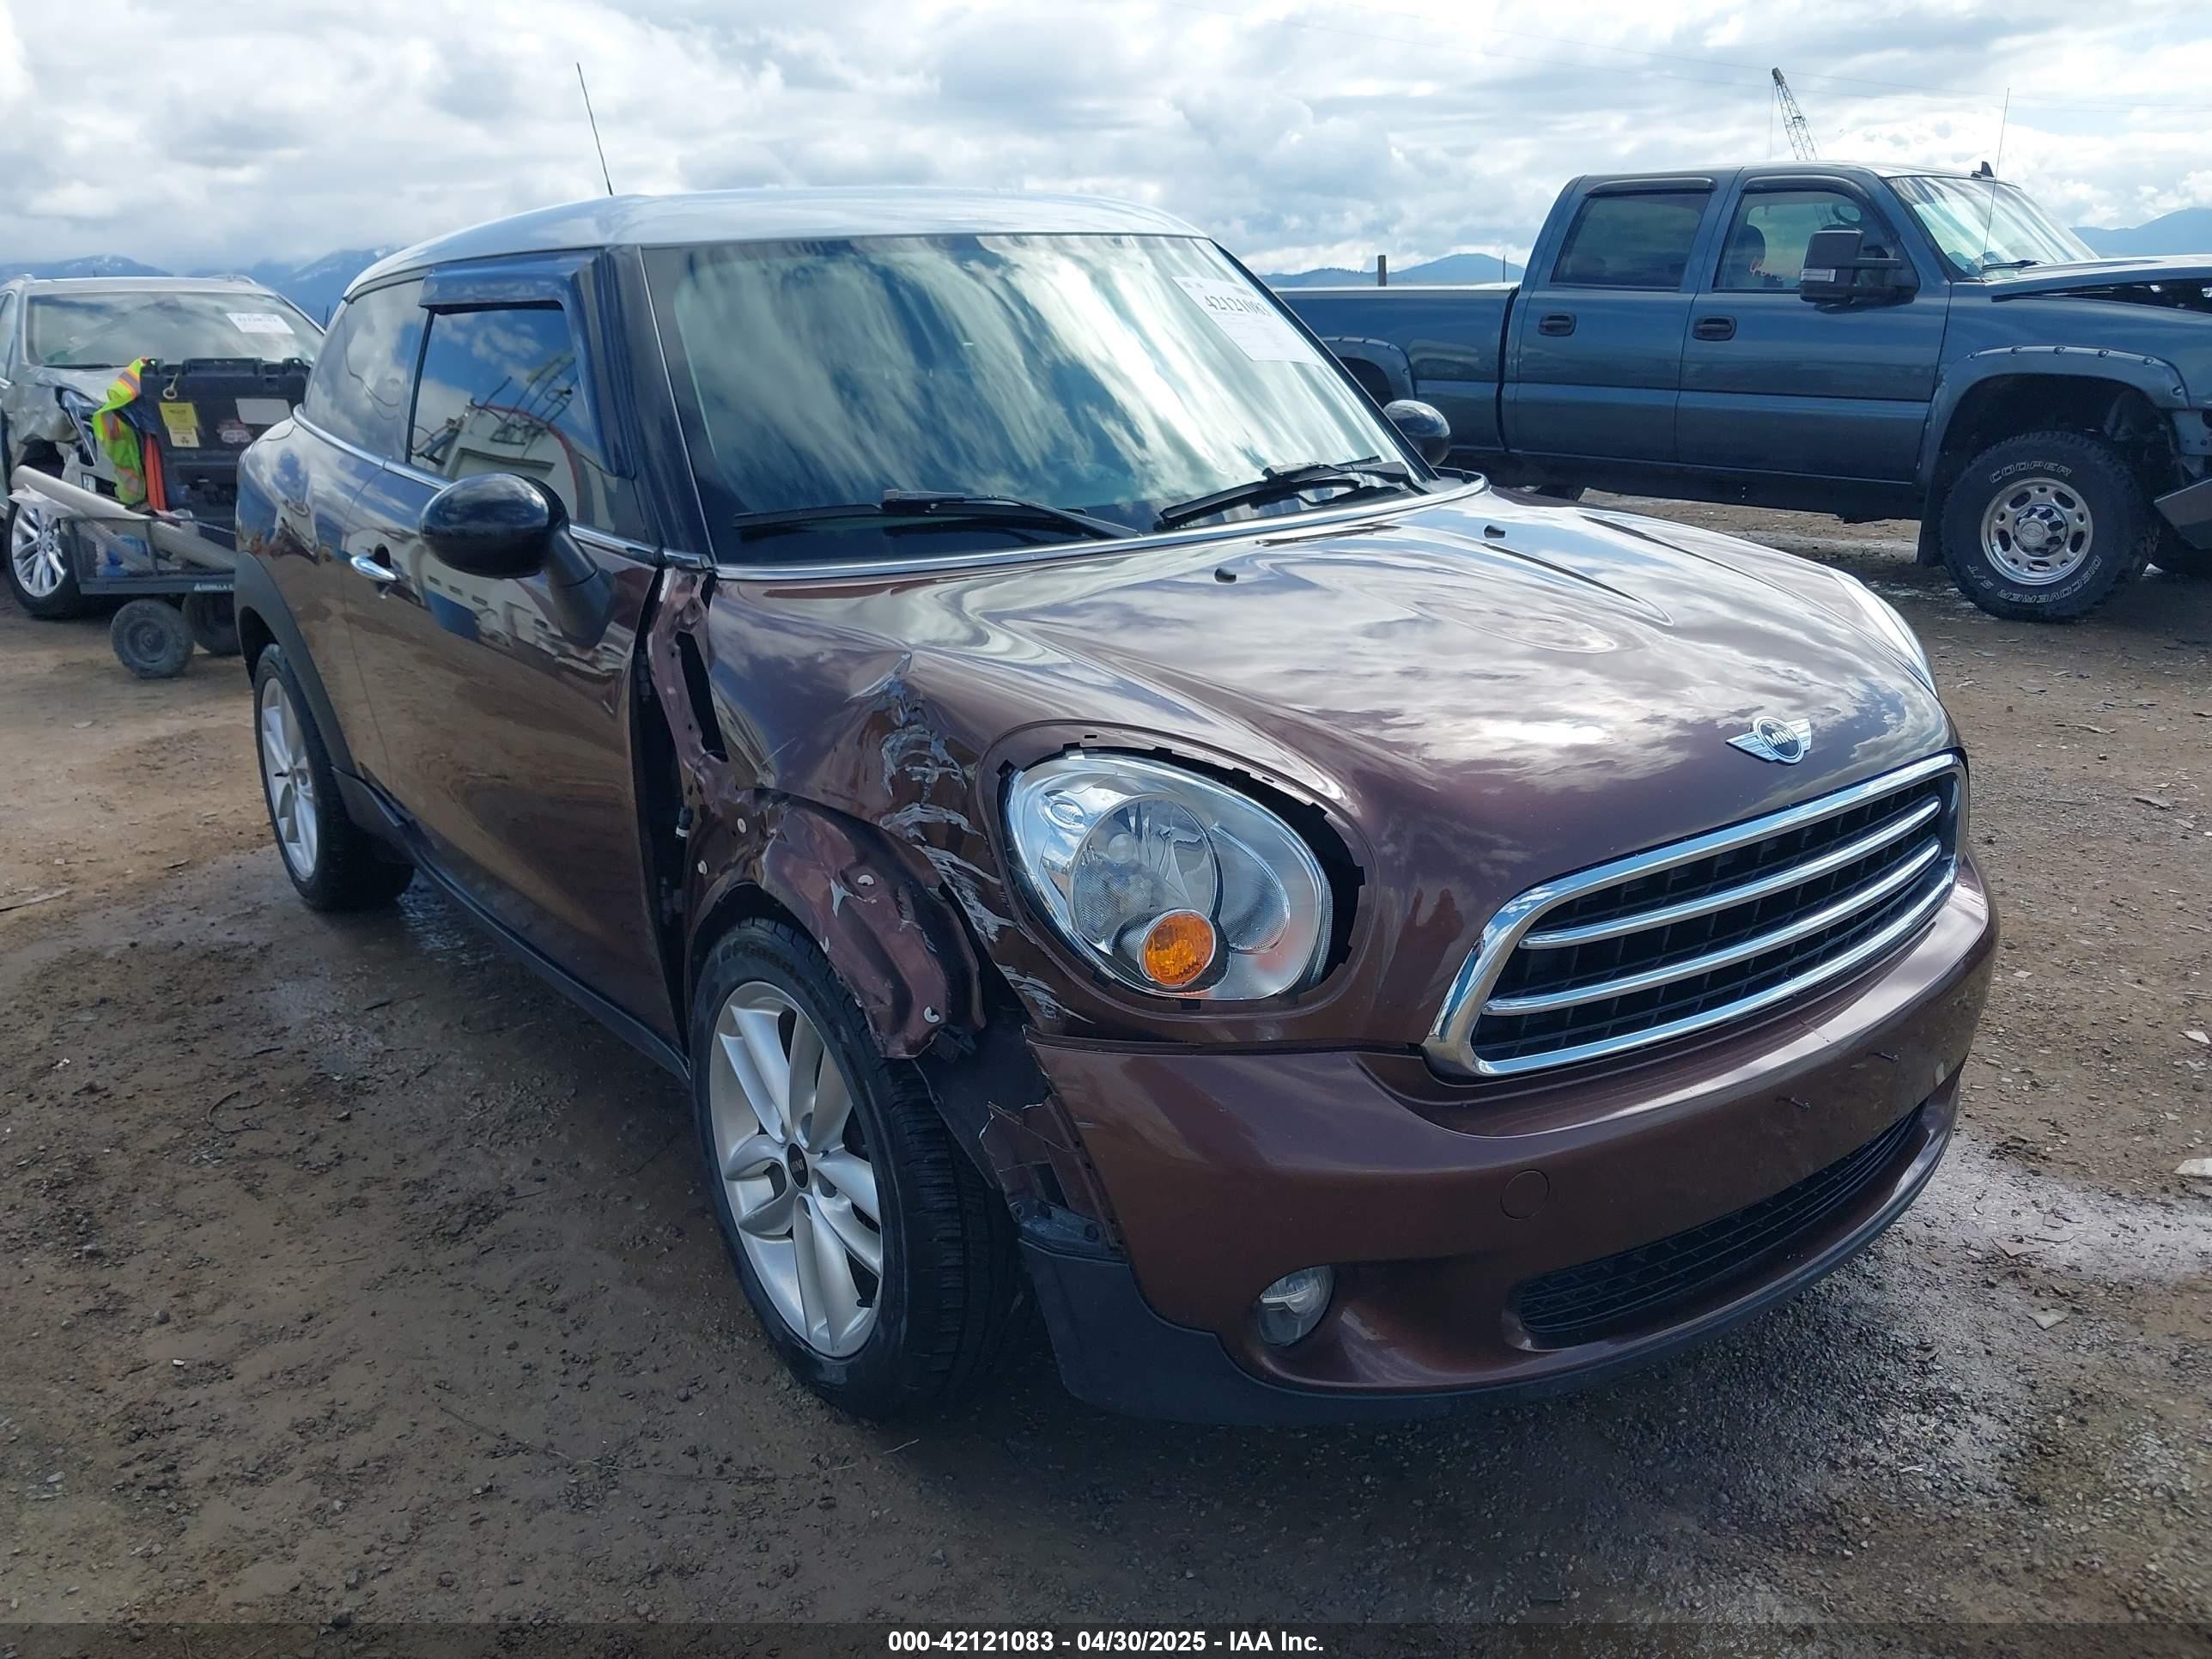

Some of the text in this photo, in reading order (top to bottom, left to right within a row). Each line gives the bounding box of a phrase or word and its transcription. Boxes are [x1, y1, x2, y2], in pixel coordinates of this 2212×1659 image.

[1990, 461, 2072, 483] COOPER
[1967, 555, 2103, 604] DISCOVERER S/T
[1765, 730, 1796, 747] MINI
